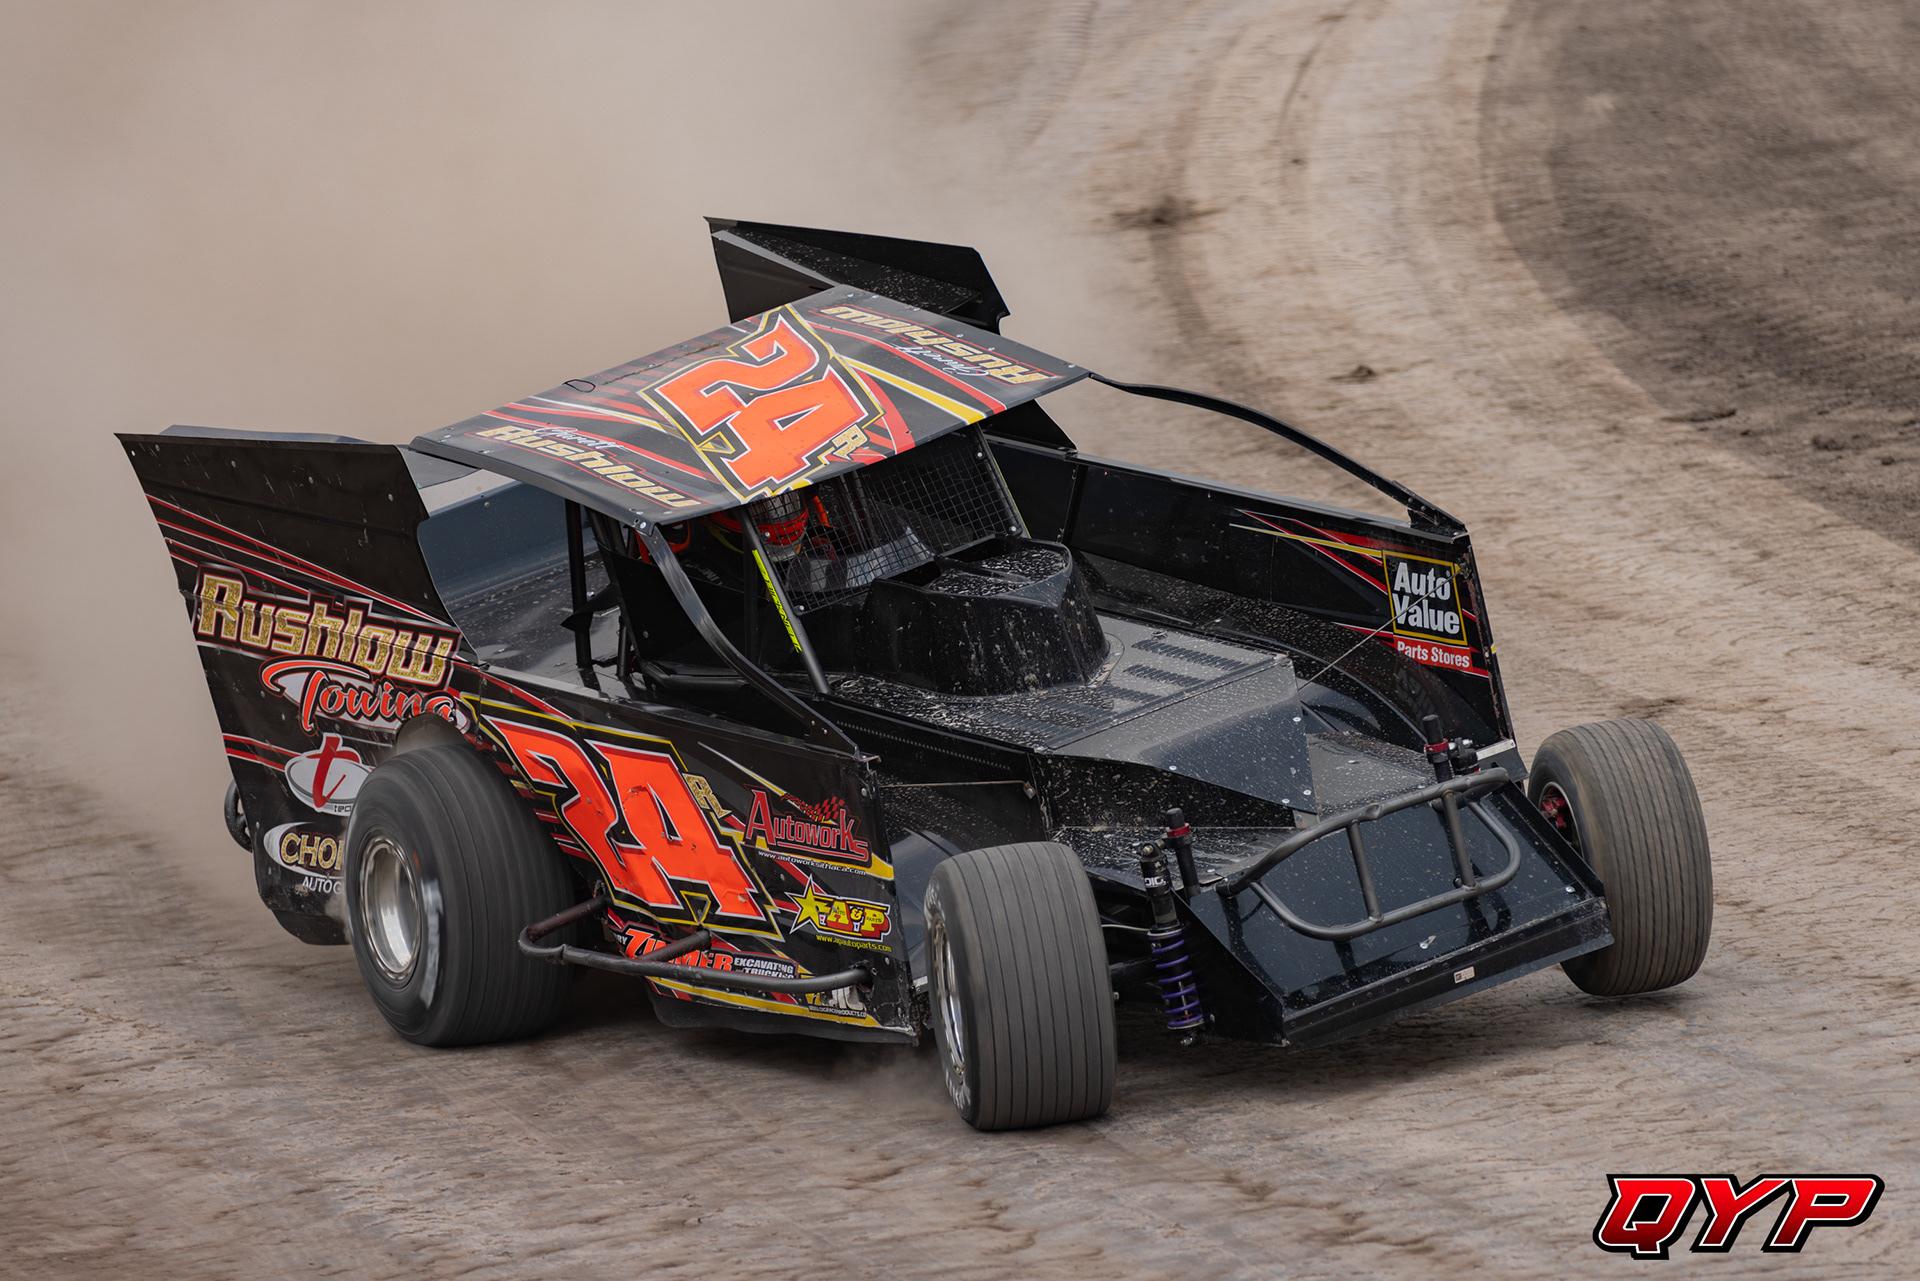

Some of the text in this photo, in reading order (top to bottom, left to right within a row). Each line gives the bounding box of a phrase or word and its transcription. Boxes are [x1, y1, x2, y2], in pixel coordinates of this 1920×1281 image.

[820, 305, 1057, 385] Rushlow
[655, 314, 868, 490] 24
[830, 425, 868, 460] R
[475, 425, 702, 507] Rushlow
[1393, 561, 1451, 601] Auto
[197, 573, 455, 687] Rushlow
[1391, 592, 1461, 635] Value
[1396, 640, 1471, 668] Parts Stores
[682, 772, 731, 819] R
[482, 714, 767, 921] 24
[745, 788, 869, 862] Autoworks
[757, 850, 867, 876] www.autoworksithaca.com
[302, 876, 333, 894] AUTO
[816, 933, 892, 953] www.apautoparts.com
[733, 957, 794, 975] EXCAVATING
